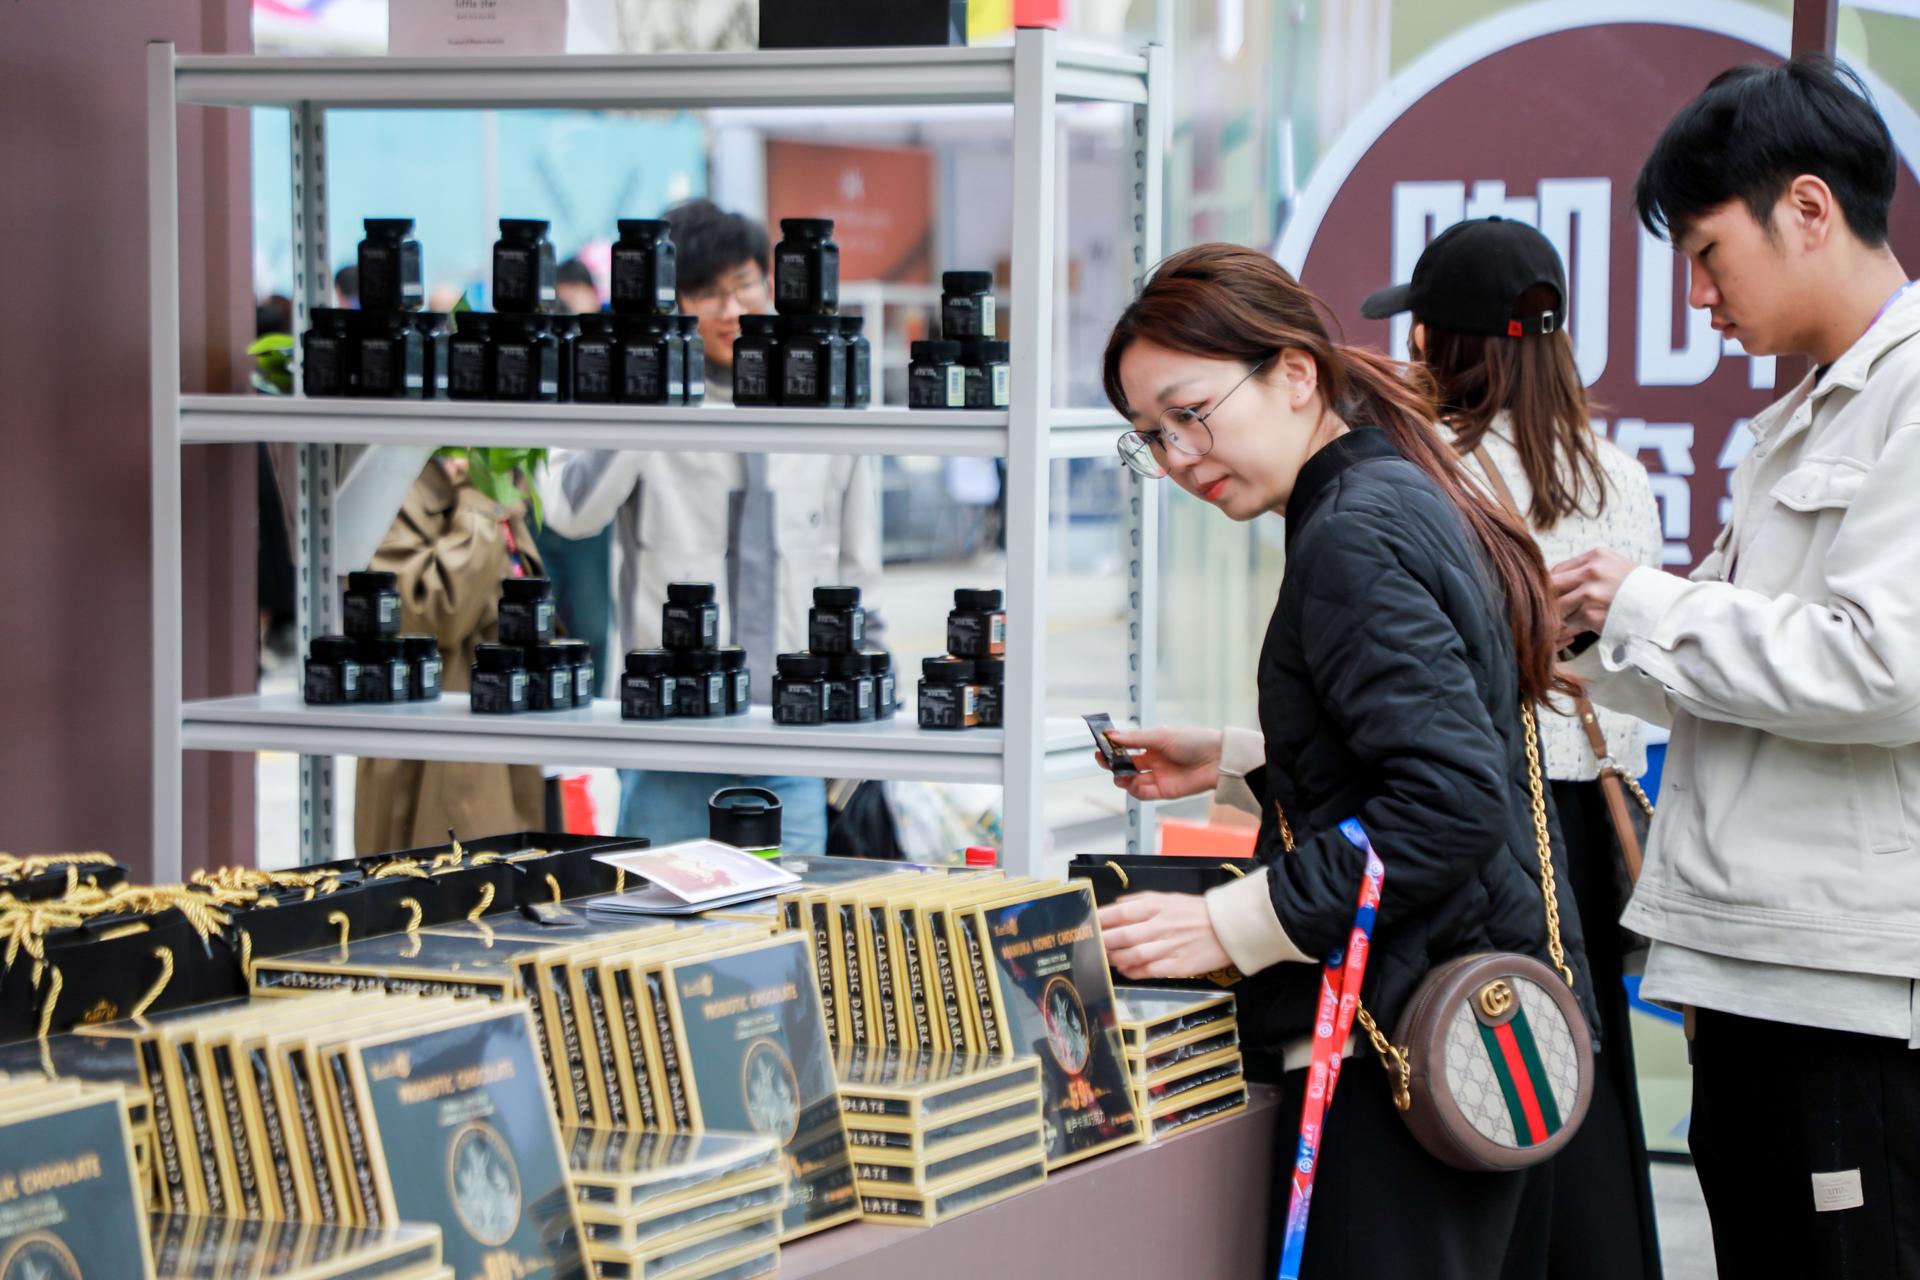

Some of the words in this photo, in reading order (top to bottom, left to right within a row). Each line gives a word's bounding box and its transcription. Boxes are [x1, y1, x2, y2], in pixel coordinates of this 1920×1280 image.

[283, 973, 341, 989] CLASSIC
[391, 981, 477, 997] CHOCOLATE
[817, 931, 832, 991] CLASSIC
[846, 932, 860, 992] CLASSIC
[877, 934, 891, 995] CLASSIC
[906, 937, 923, 999] CLASSIC
[915, 1004, 930, 1045] DARK
[936, 938, 956, 1000] CLASSIC
[947, 1006, 963, 1047] DARK
[970, 942, 990, 1003] CLASSIC
[983, 1008, 999, 1050] DARK
[559, 994, 581, 1062] CLASSIC
[573, 1068, 591, 1114] DARK
[591, 996, 613, 1064] CLASSIC
[605, 1071, 622, 1116] DARK
[623, 997, 646, 1067] CLASSIC
[637, 1073, 653, 1118] DARK
[655, 1000, 678, 1069] CLASSIC
[669, 1073, 686, 1120] DARK
[823, 998, 836, 1040] DARK
[852, 999, 865, 1040] DARK
[883, 1001, 898, 1042] DARK
